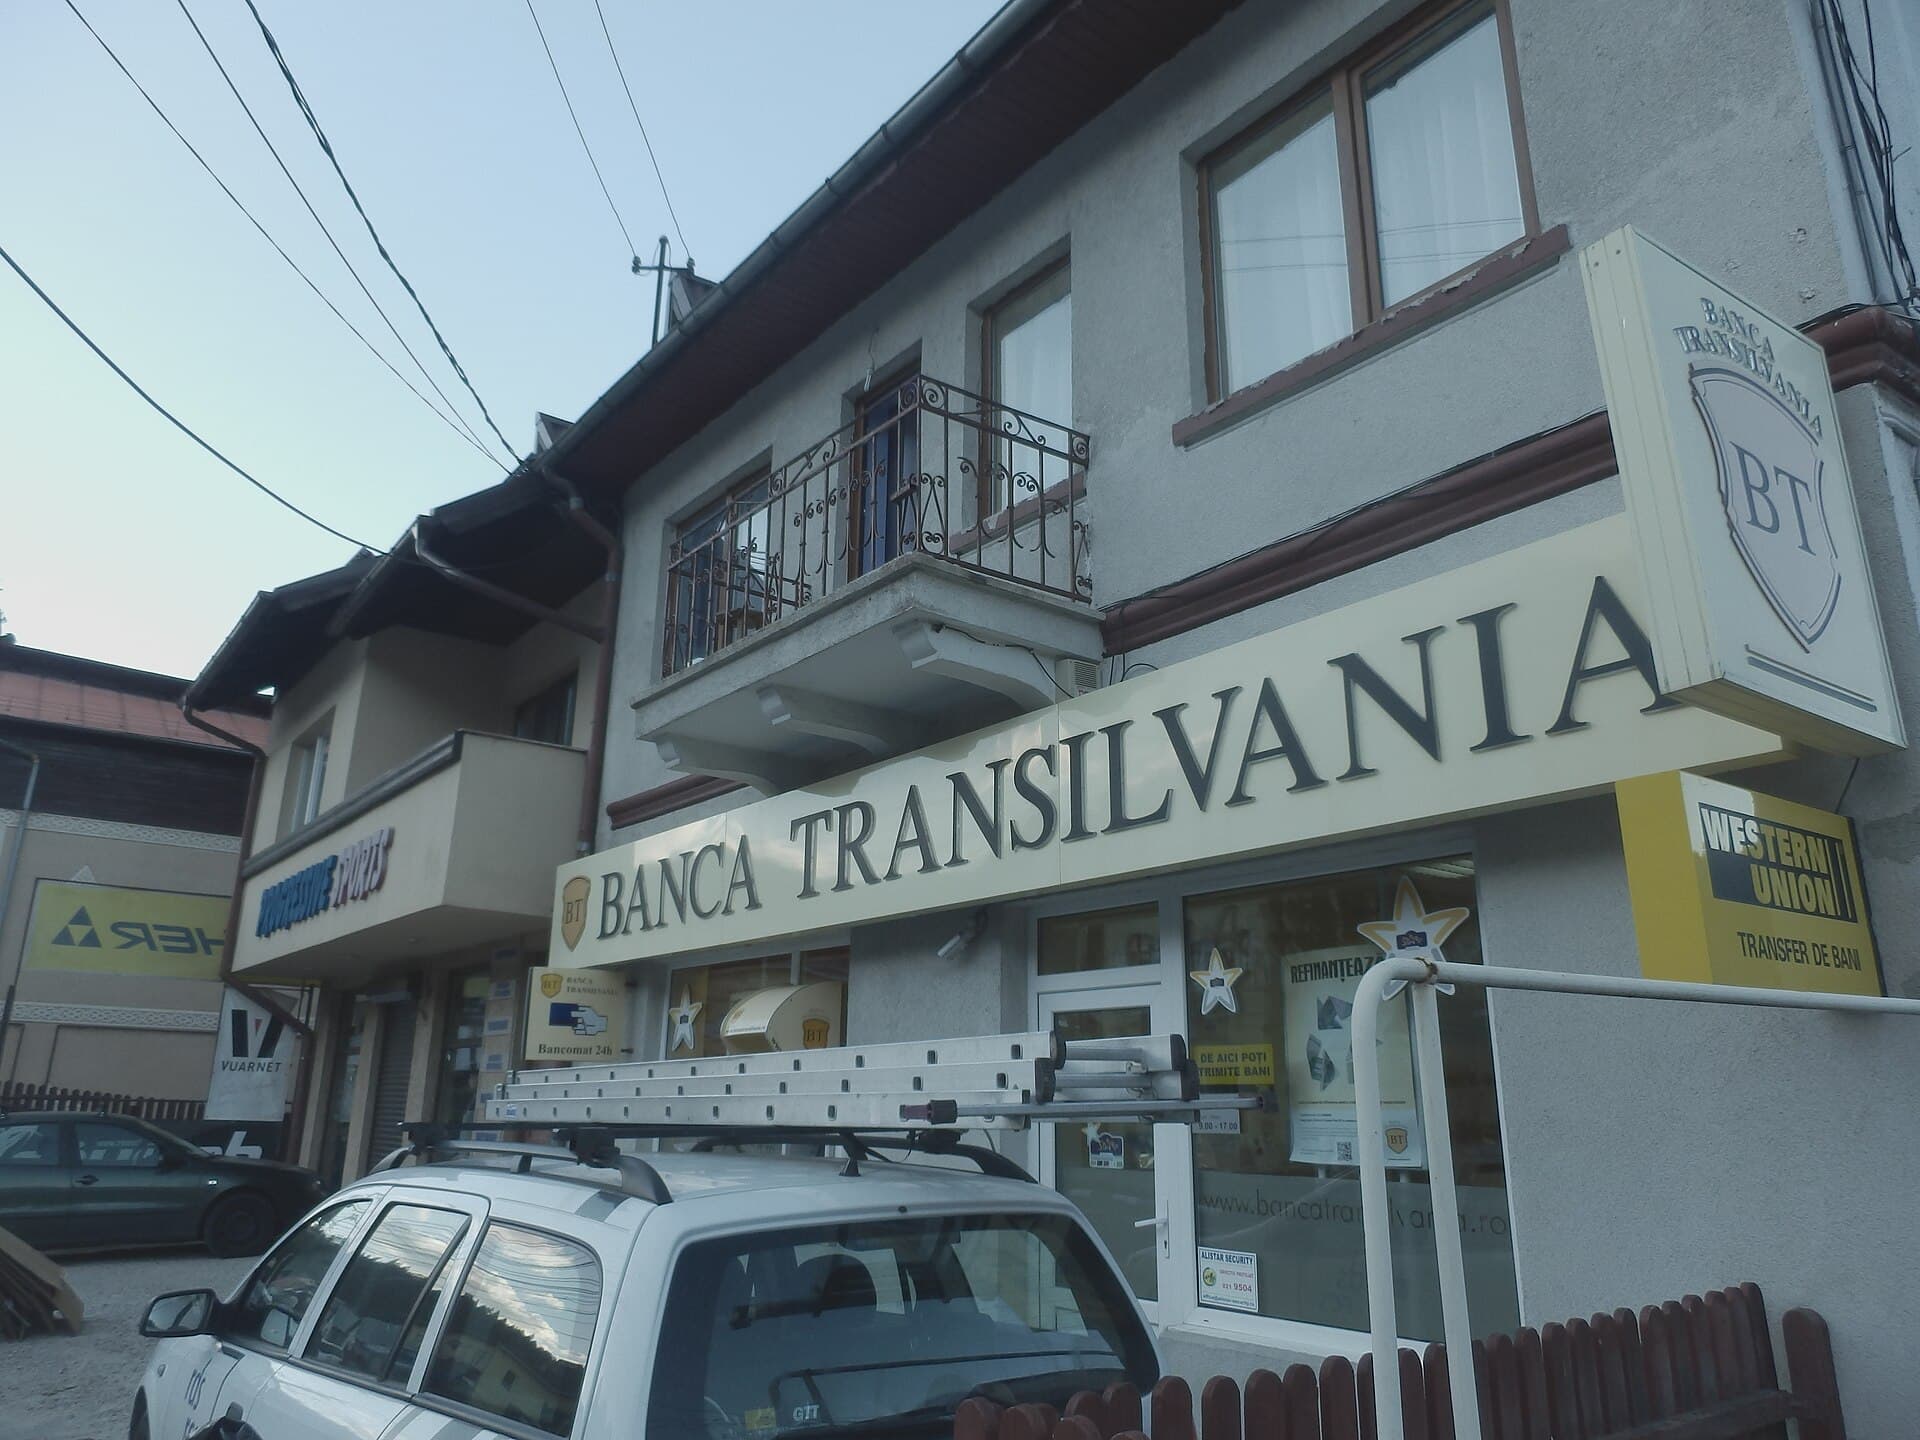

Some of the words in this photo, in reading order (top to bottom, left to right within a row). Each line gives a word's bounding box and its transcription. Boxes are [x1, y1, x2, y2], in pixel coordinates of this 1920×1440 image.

[1701, 297, 1775, 362] BANCA
[1672, 325, 1823, 438] TRANSILVANIA
[1729, 440, 1817, 556] BT
[596, 834, 763, 940] BANCA
[789, 575, 1684, 900] TRANSILVANIA
[1700, 807, 1829, 874] WESTERN
[329, 827, 396, 908] SPORTS
[1750, 863, 1837, 916] UNION
[565, 898, 584, 924] BT
[1737, 931, 1810, 964] TRANSFER
[1811, 942, 1831, 967] DE
[1831, 945, 1862, 971] BANI
[538, 1043, 593, 1055] Bancomat
[596, 1045, 613, 1056] 24h
[806, 1029, 824, 1042] BT
[221, 1061, 282, 1073] VUARNET
[1200, 1053, 1214, 1063] DE
[1217, 1052, 1238, 1063] AICI
[1200, 1066, 1240, 1077] TRIMITE
[1244, 1066, 1270, 1077] BANI
[1390, 1134, 1404, 1145] BT
[1201, 1251, 1224, 1262] ALISTAR
[1225, 1253, 1253, 1264] SECURITY
